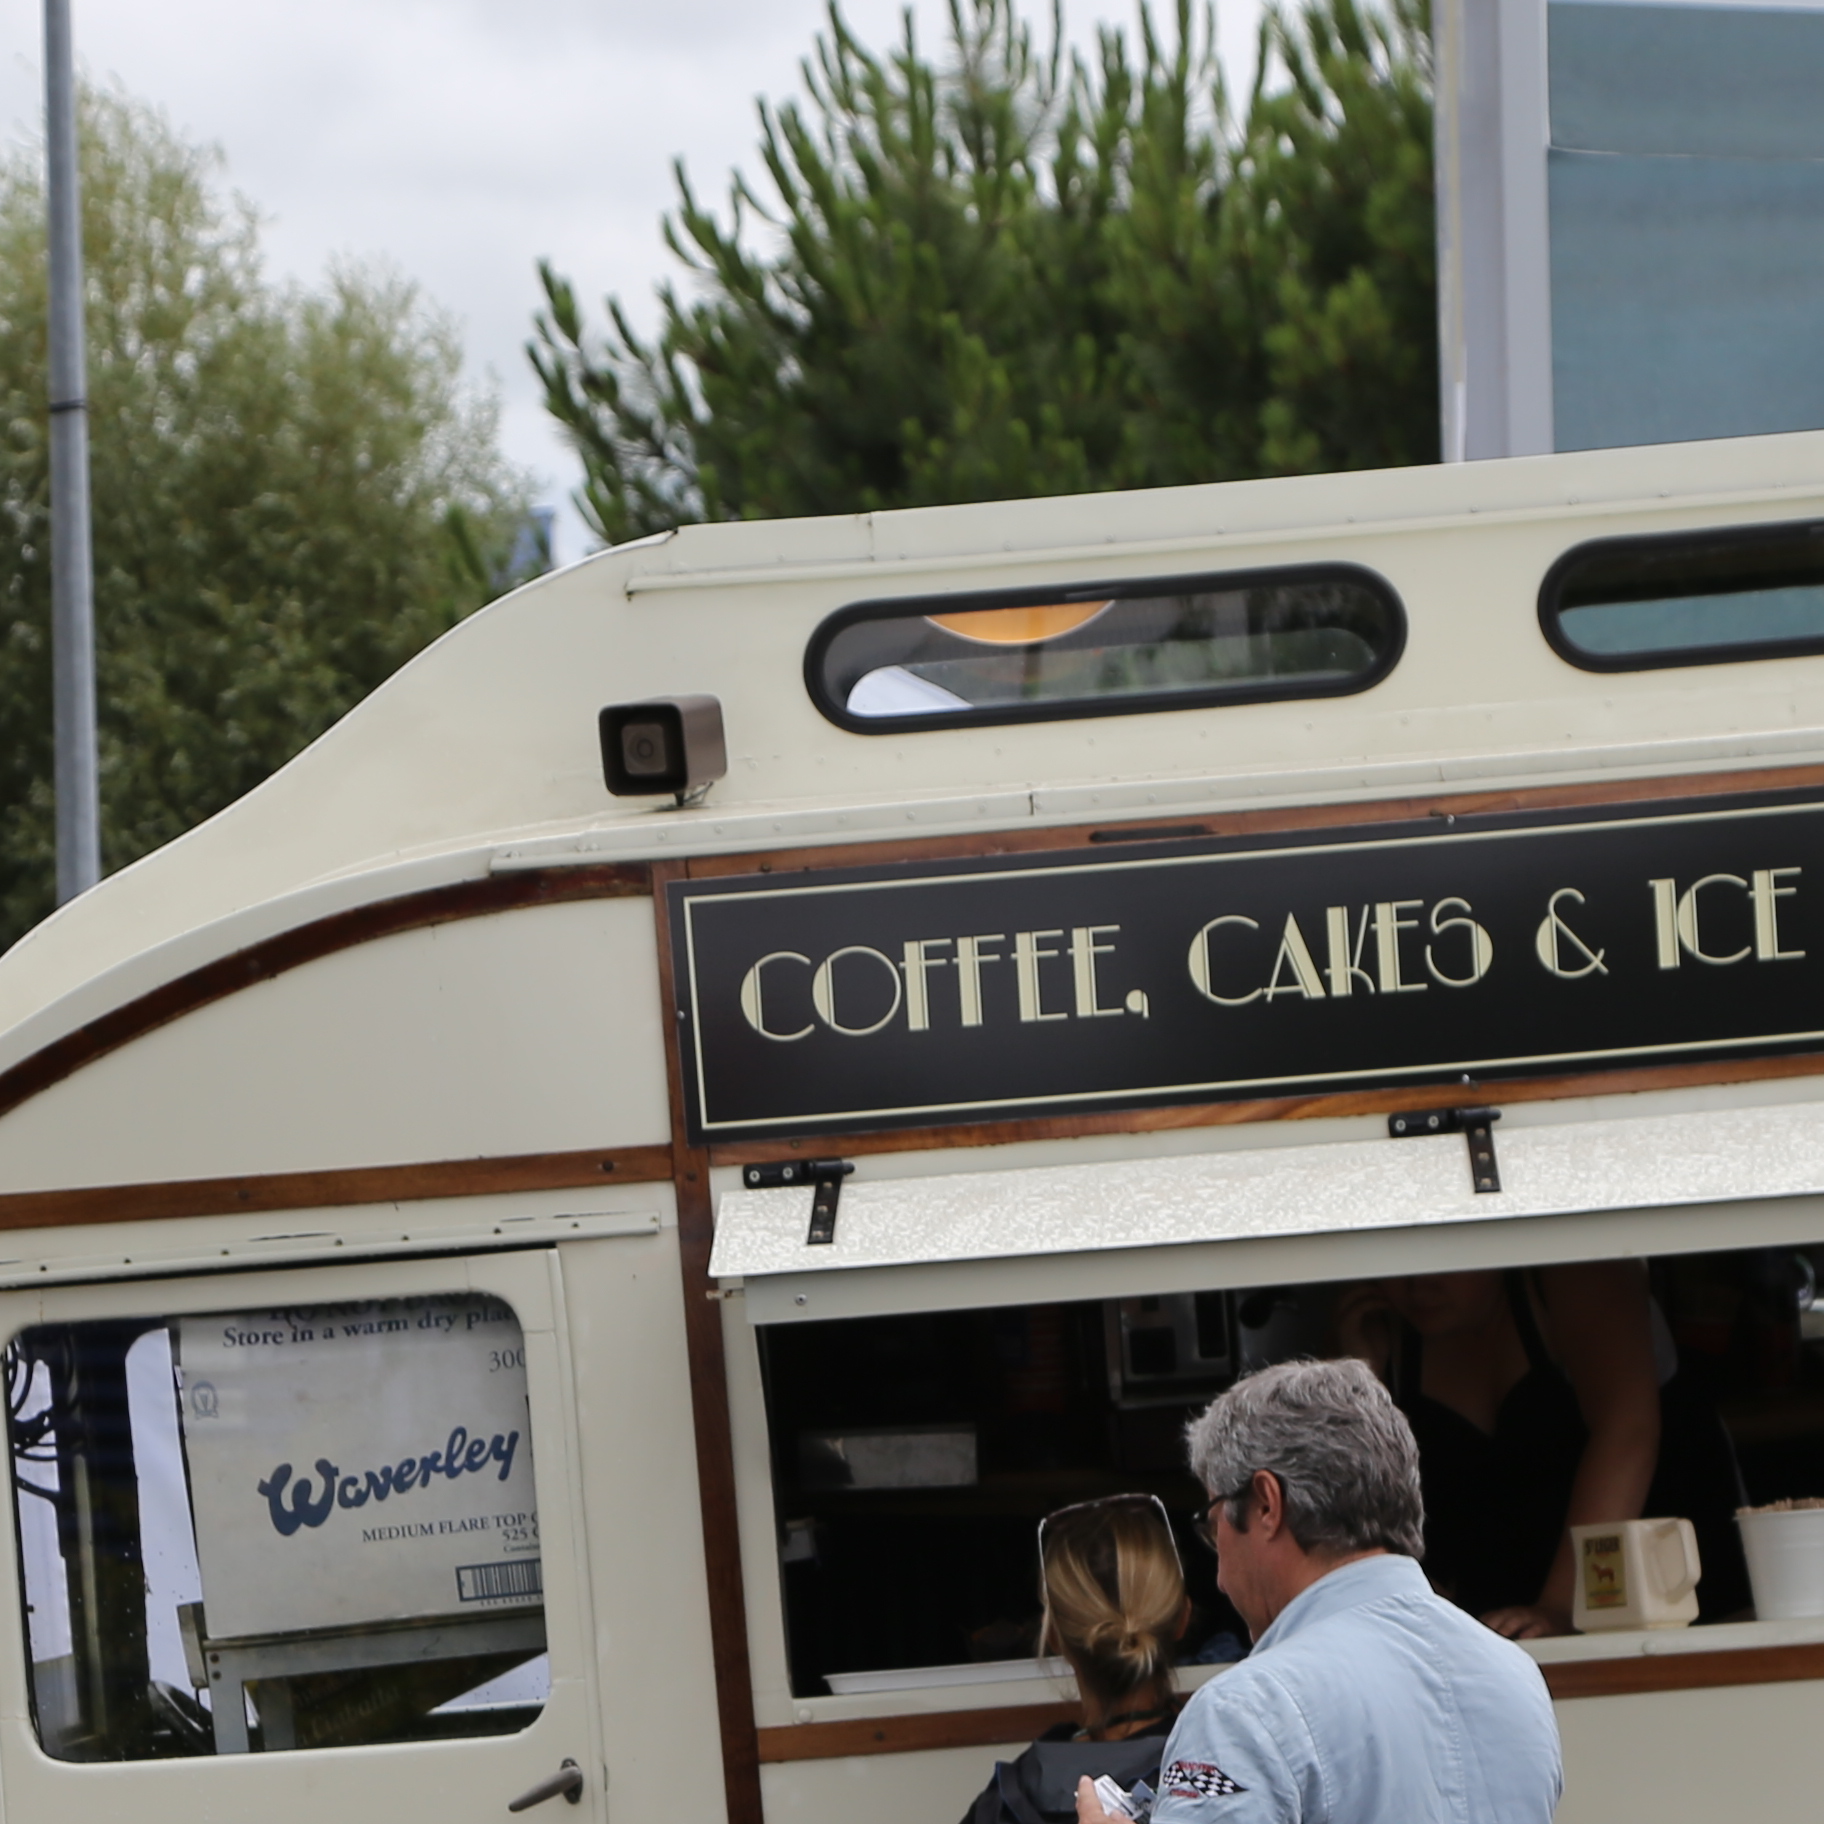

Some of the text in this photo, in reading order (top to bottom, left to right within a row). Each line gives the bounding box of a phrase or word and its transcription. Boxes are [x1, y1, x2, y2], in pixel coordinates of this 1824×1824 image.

[740, 924, 1150, 1043] COFFEE,
[1187, 896, 1493, 1006] CAKES
[1535, 887, 1610, 979] &
[1648, 866, 1807, 971] ICE
[222, 1326, 285, 1350] Store
[291, 1323, 315, 1344] in
[322, 1327, 336, 1340] a
[341, 1319, 409, 1338] warm
[416, 1308, 458, 1332] dry
[257, 1426, 520, 1537] Waverley
[362, 1523, 435, 1543] MEDIUM
[439, 1516, 491, 1535] FLARE
[492, 1511, 527, 1528] TOP
[502, 1527, 529, 1542] 525
